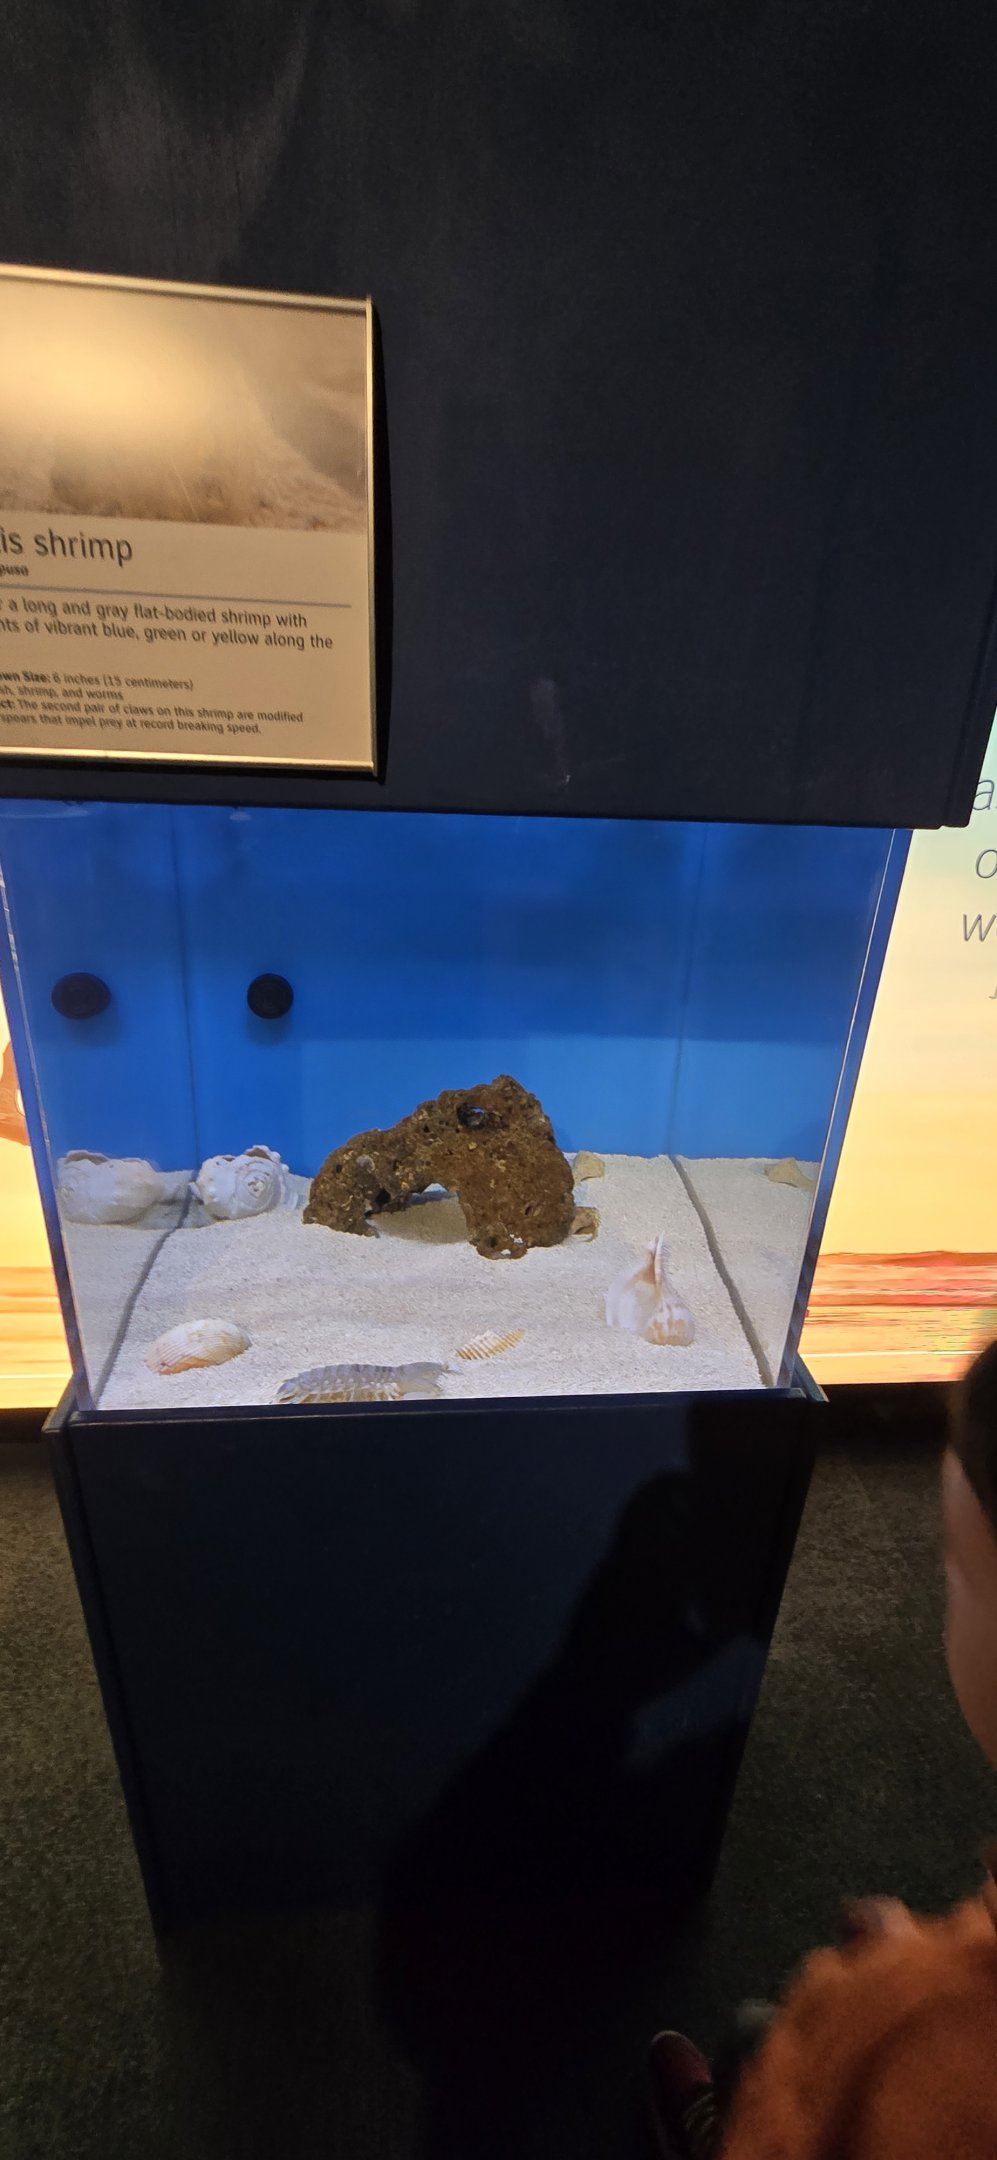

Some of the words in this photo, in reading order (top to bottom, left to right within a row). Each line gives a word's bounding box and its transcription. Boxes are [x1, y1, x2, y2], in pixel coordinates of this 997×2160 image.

[0, 526, 23, 555] is
[33, 527, 132, 568] shrimp
[8, 598, 18, 611] a
[22, 596, 58, 617] long
[62, 600, 91, 616] and
[96, 603, 128, 621] gray
[133, 602, 216, 623] flat-bodied
[221, 609, 271, 629] shrimp
[276, 612, 307, 628] with
[25, 617, 40, 633] of
[44, 619, 98, 637] vibrant
[101, 622, 139, 640] blue,
[144, 626, 186, 643] green
[192, 629, 207, 642] or
[211, 629, 259, 646] yellow
[264, 632, 305, 651] along
[310, 634, 333, 649] the
[22, 671, 51, 683] Size:
[63, 674, 100, 686] inches
[125, 677, 194, 691] centimeters)
[18, 686, 58, 698] shrimp,
[62, 688, 83, 698] and
[86, 690, 124, 701] worms
[17, 699, 38, 710] The
[40, 701, 81, 713] second
[84, 703, 105, 716] pair
[109, 704, 120, 714] of
[123, 705, 154, 716] claws
[156, 706, 171, 717] on
[174, 706, 194, 718] this
[197, 708, 234, 721] shrimp
[237, 710, 254, 720] are
[257, 711, 303, 722] modified
[39, 714, 62, 725] that
[65, 715, 96, 729] impel
[99, 718, 122, 729] prey
[126, 719, 137, 728] at
[140, 719, 174, 730] record
[177, 720, 224, 735] breaking
[227, 724, 261, 735] speed.
